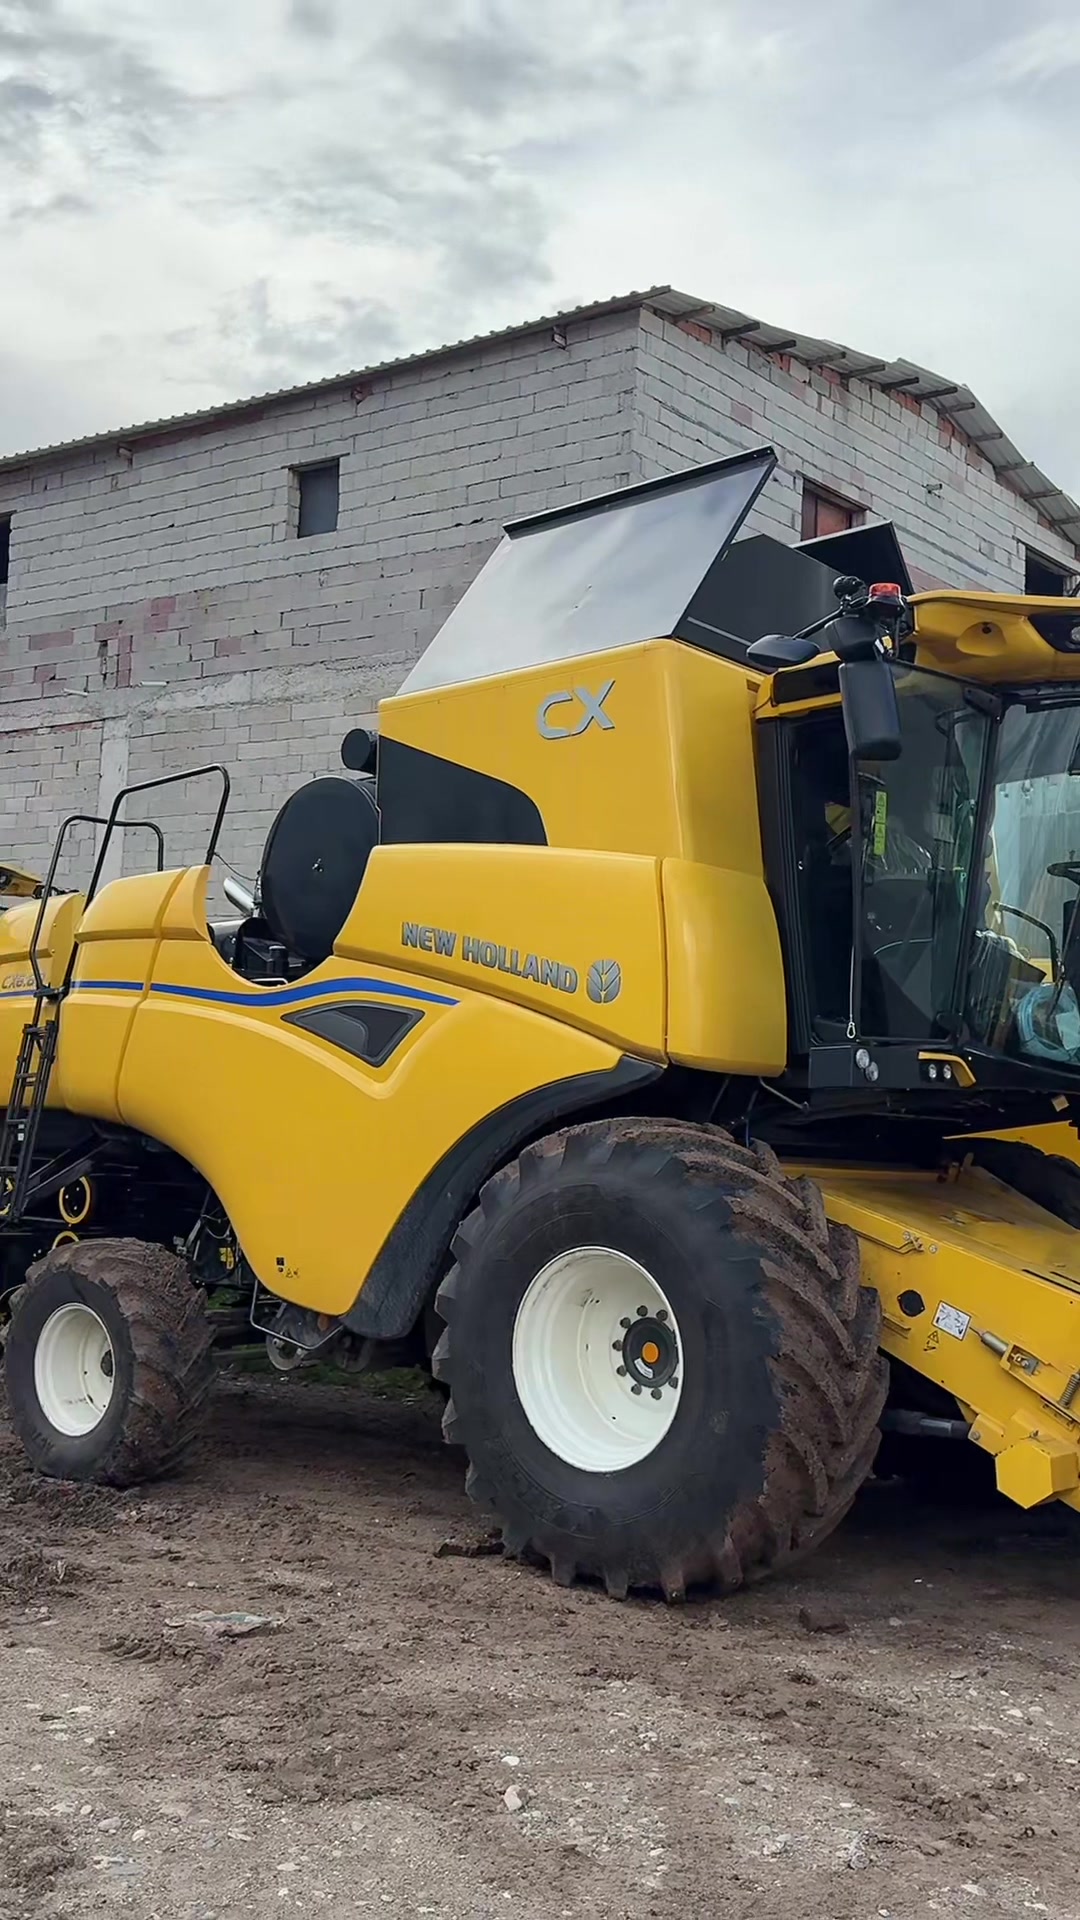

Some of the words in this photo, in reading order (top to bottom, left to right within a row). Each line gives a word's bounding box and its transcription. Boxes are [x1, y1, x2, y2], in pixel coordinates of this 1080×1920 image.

[537, 679, 616, 741] CX
[401, 921, 457, 957] NEW
[462, 936, 578, 993] HOLLAND
